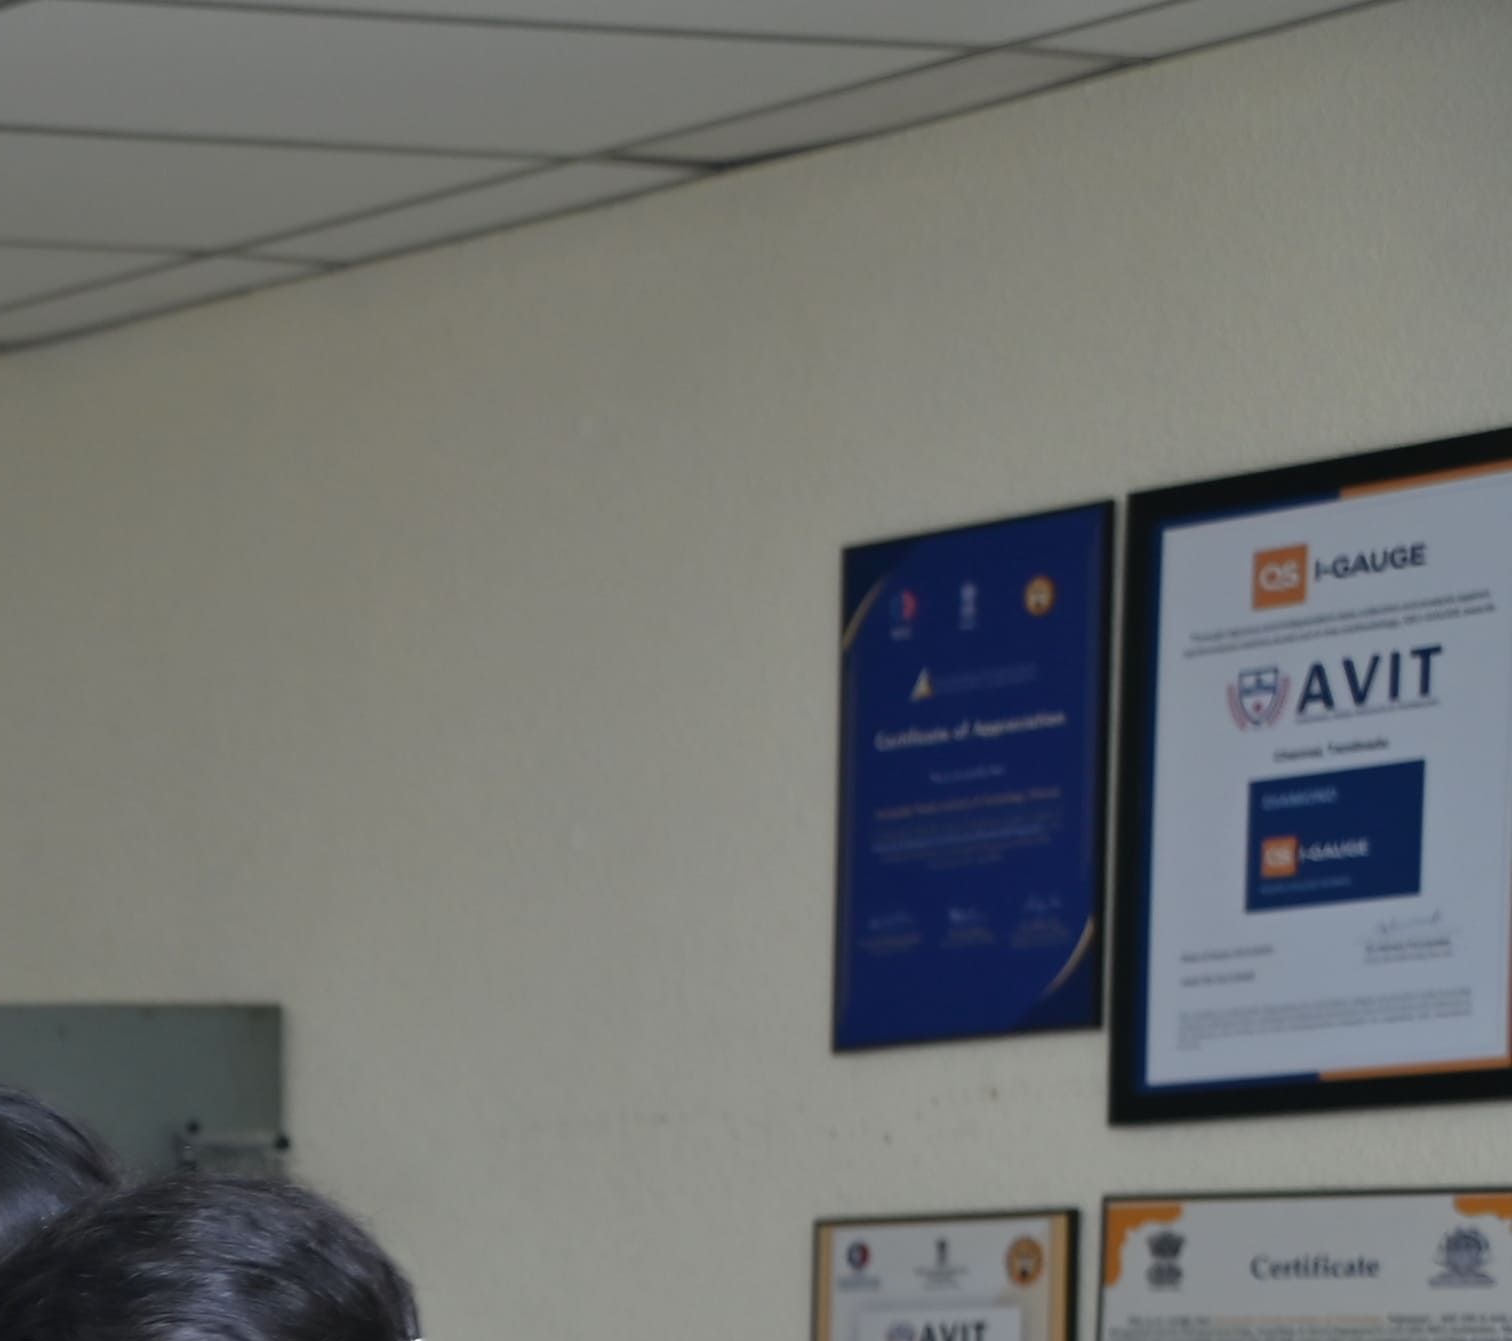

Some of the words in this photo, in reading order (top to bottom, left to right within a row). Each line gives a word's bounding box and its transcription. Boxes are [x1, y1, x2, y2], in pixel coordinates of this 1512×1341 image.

[1313, 543, 1428, 582] I-GAUGE
[1296, 643, 1443, 715] AVIT
[1249, 1254, 1381, 1281] Certificate
